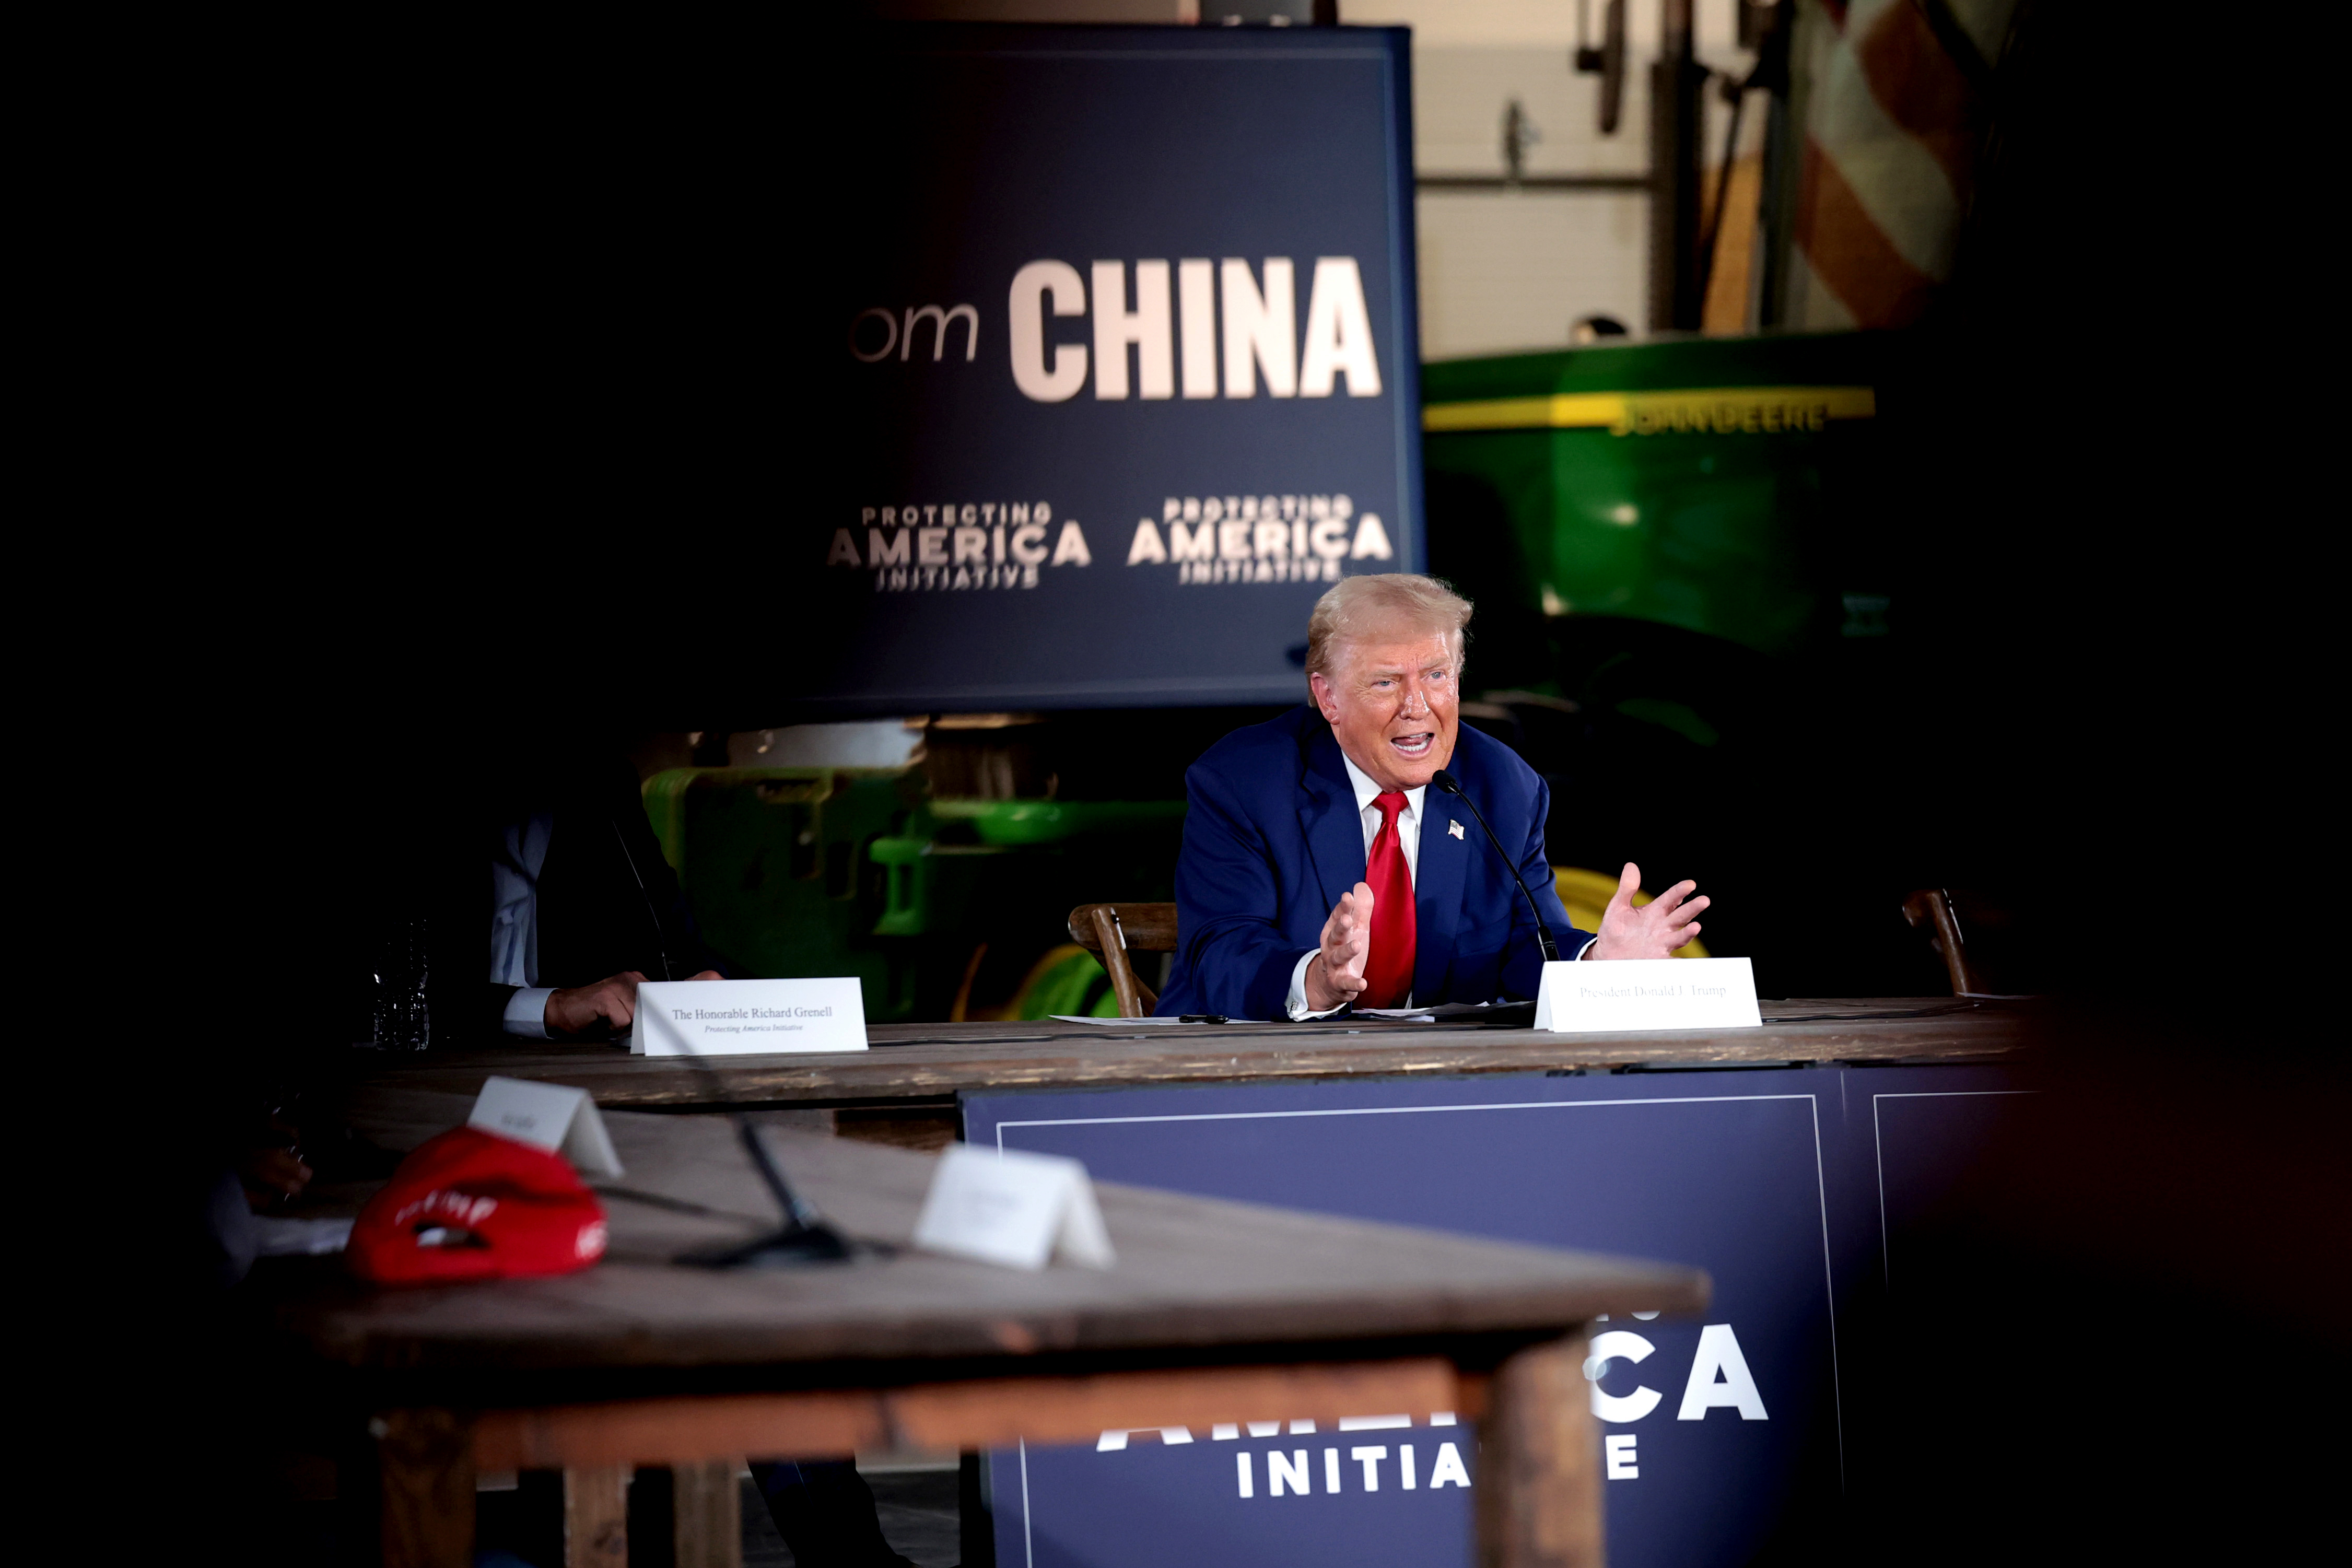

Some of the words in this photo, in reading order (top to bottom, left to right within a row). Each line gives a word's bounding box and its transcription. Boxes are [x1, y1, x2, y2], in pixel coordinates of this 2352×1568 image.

[848, 302, 979, 363] om
[1009, 256, 1383, 402] CHINA
[862, 501, 1052, 526] PROTECTING
[1163, 493, 1353, 523] PROTECTING
[827, 520, 1092, 568] AMERICA
[1126, 512, 1393, 566] AMERICA
[876, 565, 1038, 591] INITIATIVE
[1580, 986, 1631, 998] President
[1635, 985, 1674, 997] Donald
[1678, 985, 1687, 996] J.
[1691, 985, 1726, 998] Trump
[672, 1009, 692, 1020] The
[695, 1008, 748, 1020] Honorable
[752, 1007, 791, 1019] Richard
[794, 1006, 832, 1017] Grenell
[705, 1025, 740, 1034] Protecting
[1236, 1434, 1639, 1499] INITIAE
